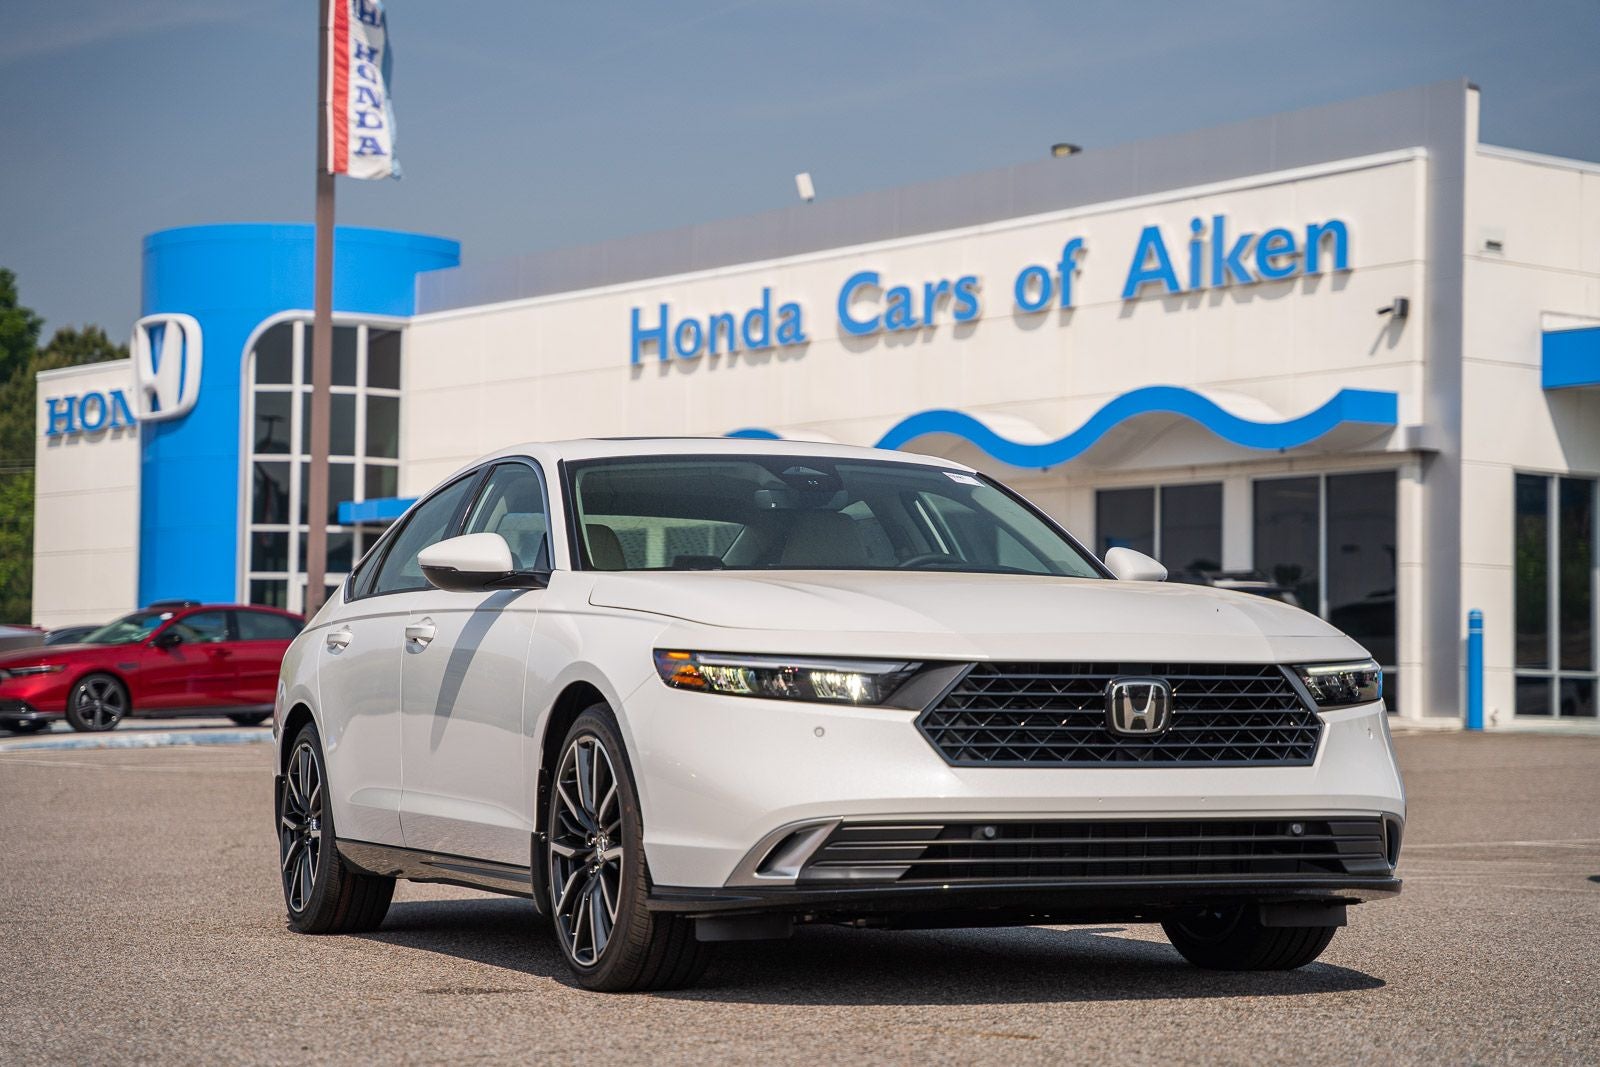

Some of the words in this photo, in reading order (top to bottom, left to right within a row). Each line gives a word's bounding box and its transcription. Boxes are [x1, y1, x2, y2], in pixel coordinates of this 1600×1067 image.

[354, 38, 386, 156] HONDA
[630, 287, 807, 366] Honda
[836, 271, 980, 336] Cars
[1013, 237, 1084, 313] of
[1121, 214, 1349, 299] Aiken
